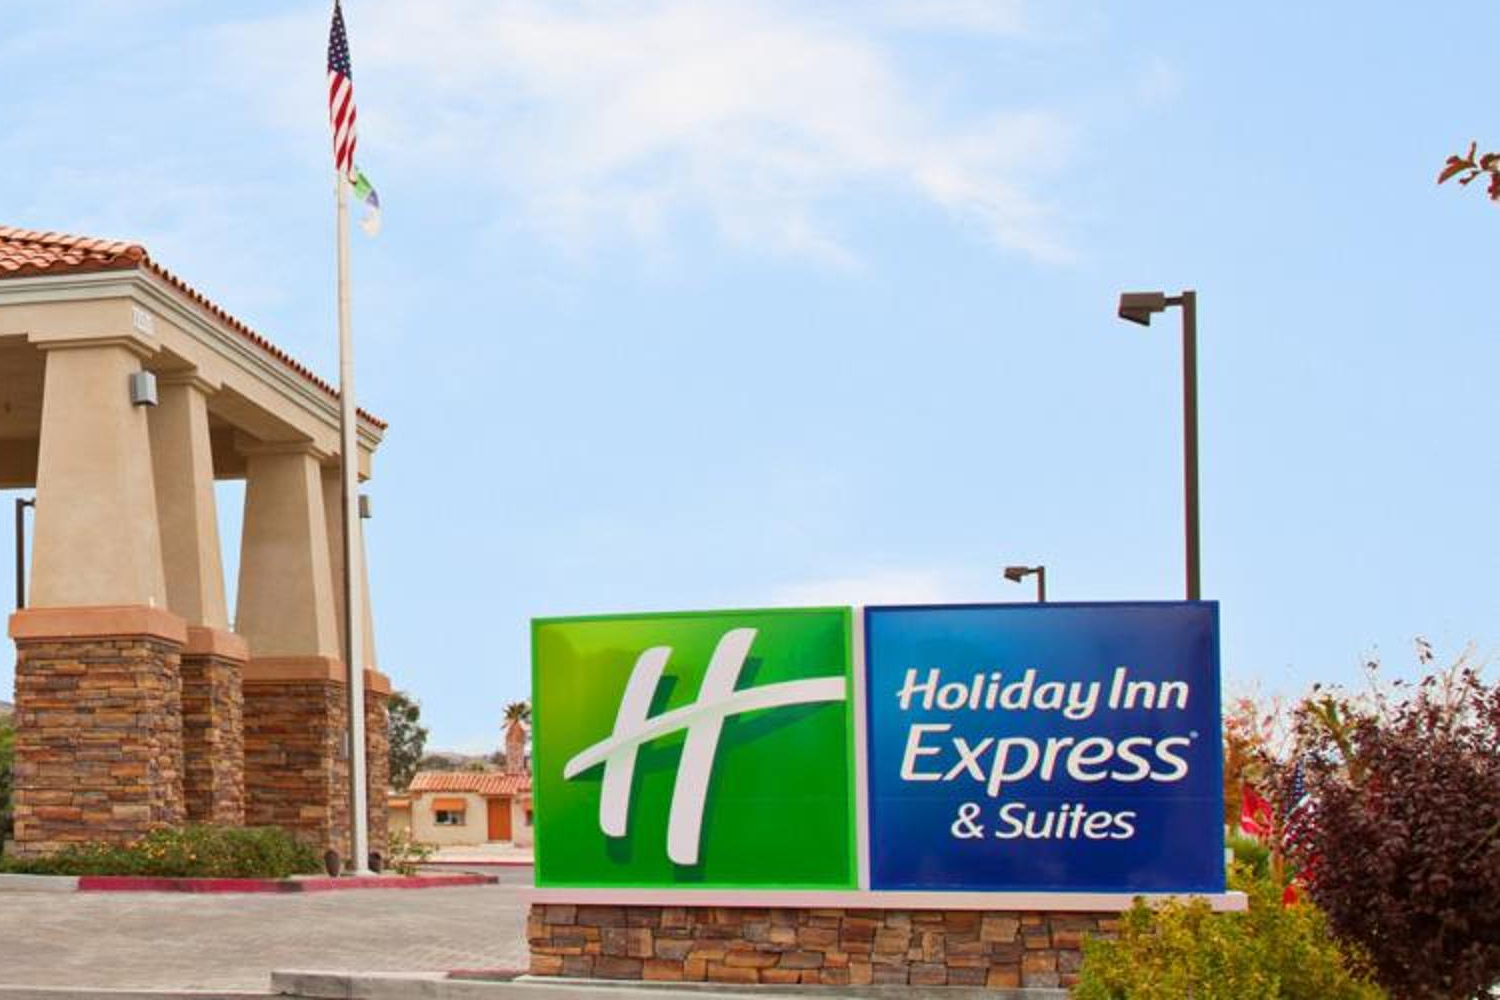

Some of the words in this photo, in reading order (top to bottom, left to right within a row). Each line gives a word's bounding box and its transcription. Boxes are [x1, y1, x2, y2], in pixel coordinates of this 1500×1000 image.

[896, 667, 1101, 721] Holiday
[1108, 666, 1190, 710] Inn
[563, 627, 847, 865] H
[900, 722, 1192, 798] Express
[950, 801, 985, 840] &
[994, 802, 1137, 840] Suites
